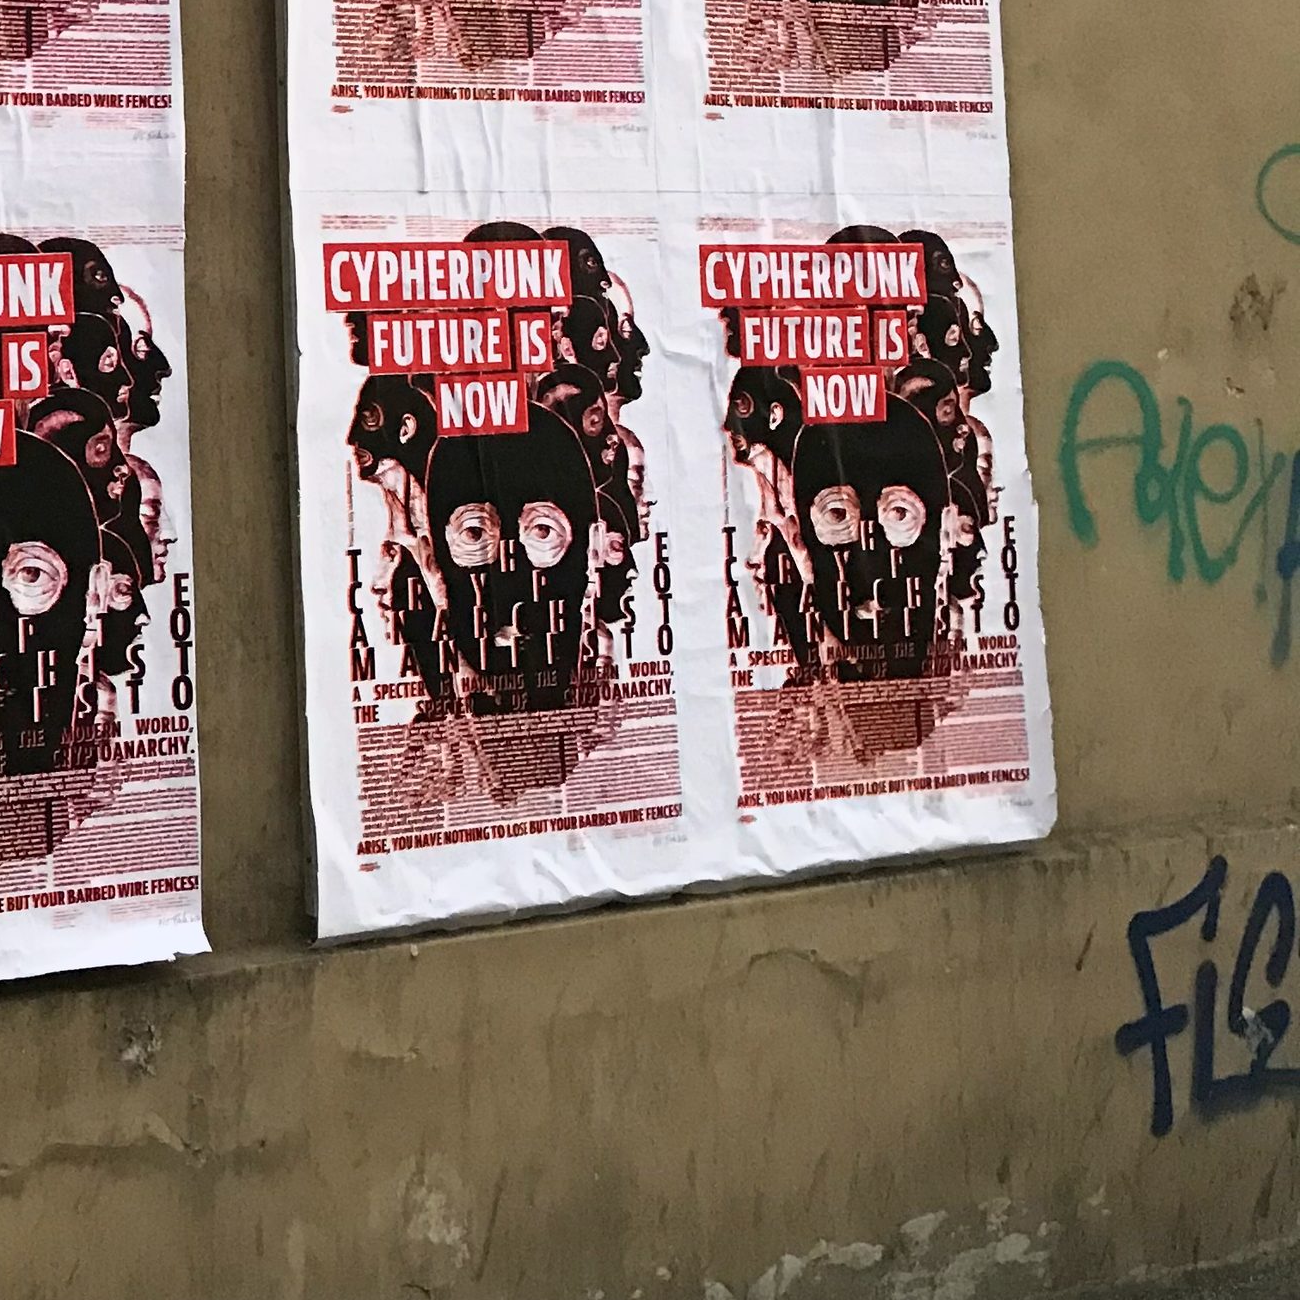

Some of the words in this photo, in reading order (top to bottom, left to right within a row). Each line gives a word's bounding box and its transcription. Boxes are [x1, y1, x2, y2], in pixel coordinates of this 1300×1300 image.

[12, 92, 43, 106] YOUR
[45, 93, 91, 107] BARBED
[93, 94, 123, 107] WIRE
[125, 94, 171, 107] FENCES!
[363, 85, 385, 99] YOU
[386, 86, 413, 99] HAVE
[414, 86, 456, 100] NOTHING
[459, 87, 471, 100] TO
[473, 87, 495, 100] LOSE
[498, 88, 516, 101] BUT
[517, 89, 542, 101] YOUR
[544, 89, 581, 102] BARBED
[582, 90, 607, 102] WIRE
[329, 249, 564, 302] CYPHERPUNK
[704, 251, 919, 299] CYPHERPUNK
[372, 318, 503, 366] FUTURE
[519, 320, 546, 364] IS
[743, 316, 862, 359] FUTURE
[878, 318, 903, 359] IS
[8, 341, 40, 390] IS
[441, 380, 517, 428] NOW
[806, 374, 876, 417] NOW
[748, 649, 795, 666] SPECTER
[372, 680, 426, 701] SPECTER
[730, 670, 753, 686] THE
[353, 705, 379, 723] THE
[18, 730, 44, 748] THE
[60, 721, 121, 744] MODERN
[52, 735, 193, 768] CRYPTOANARCHY.
[356, 838, 390, 857] ARISE,
[391, 835, 413, 852] YOU
[414, 831, 442, 849] HAVE
[443, 826, 489, 845] NOTHING
[491, 824, 505, 839] TO
[507, 821, 529, 838] LOSE
[529, 818, 549, 834] BUT
[550, 815, 577, 832] YOUR
[577, 811, 617, 829] BARBED
[618, 808, 644, 824] WIRE
[645, 803, 682, 820] FENCES!
[6, 894, 30, 912] BUT
[32, 890, 65, 909] YOUR
[67, 884, 115, 905] BARBED
[117, 880, 149, 898] WIRE
[150, 874, 198, 894] FENCES!
